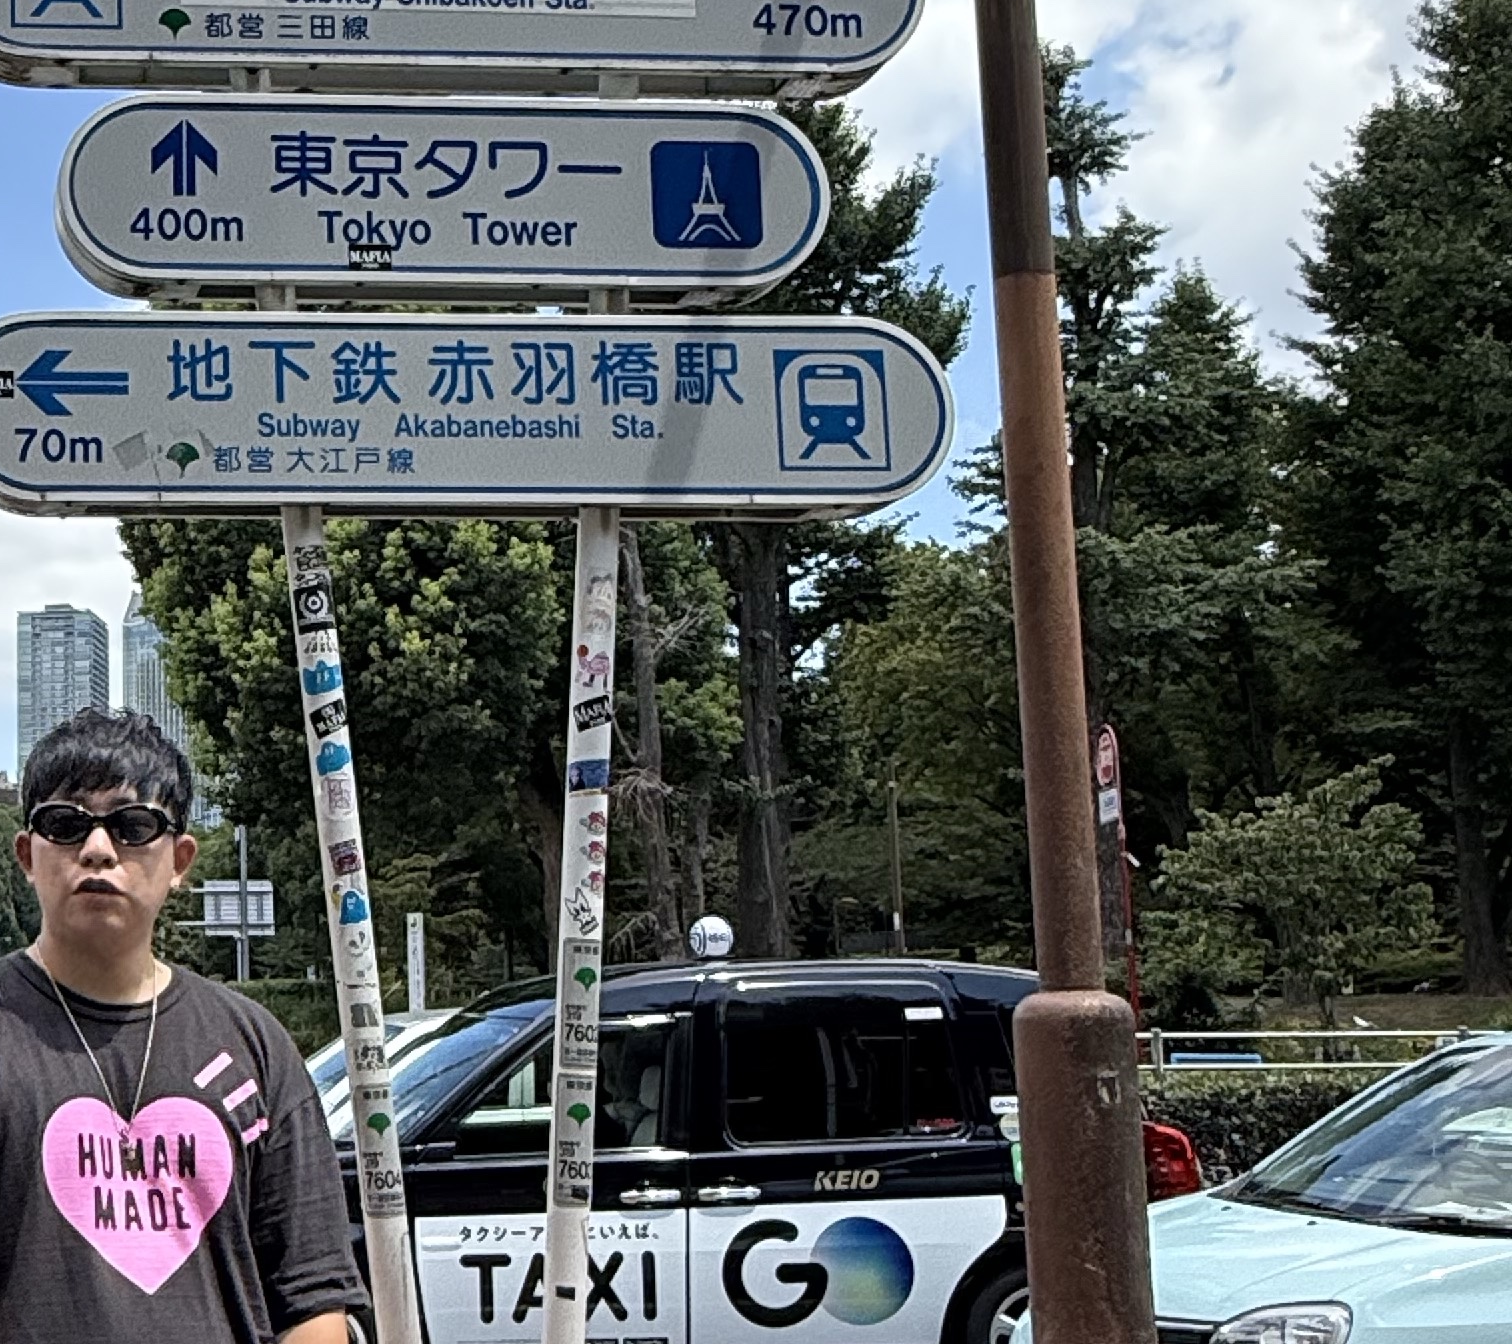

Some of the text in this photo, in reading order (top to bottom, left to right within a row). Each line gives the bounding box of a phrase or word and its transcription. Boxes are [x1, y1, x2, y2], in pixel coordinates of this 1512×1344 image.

[752, 4, 863, 39] 470m
[269, 131, 623, 200] 東京タワー
[129, 208, 245, 243] 400m
[317, 209, 579, 252] Tokyo Tower
[14, 427, 104, 464] 70m
[257, 412, 664, 443] Subway Akabanebashi Sta.
[77, 1132, 197, 1181] HUMAN
[814, 1168, 880, 1192] KEIO
[93, 1185, 192, 1232] MADE
[722, 1216, 915, 1329] GO
